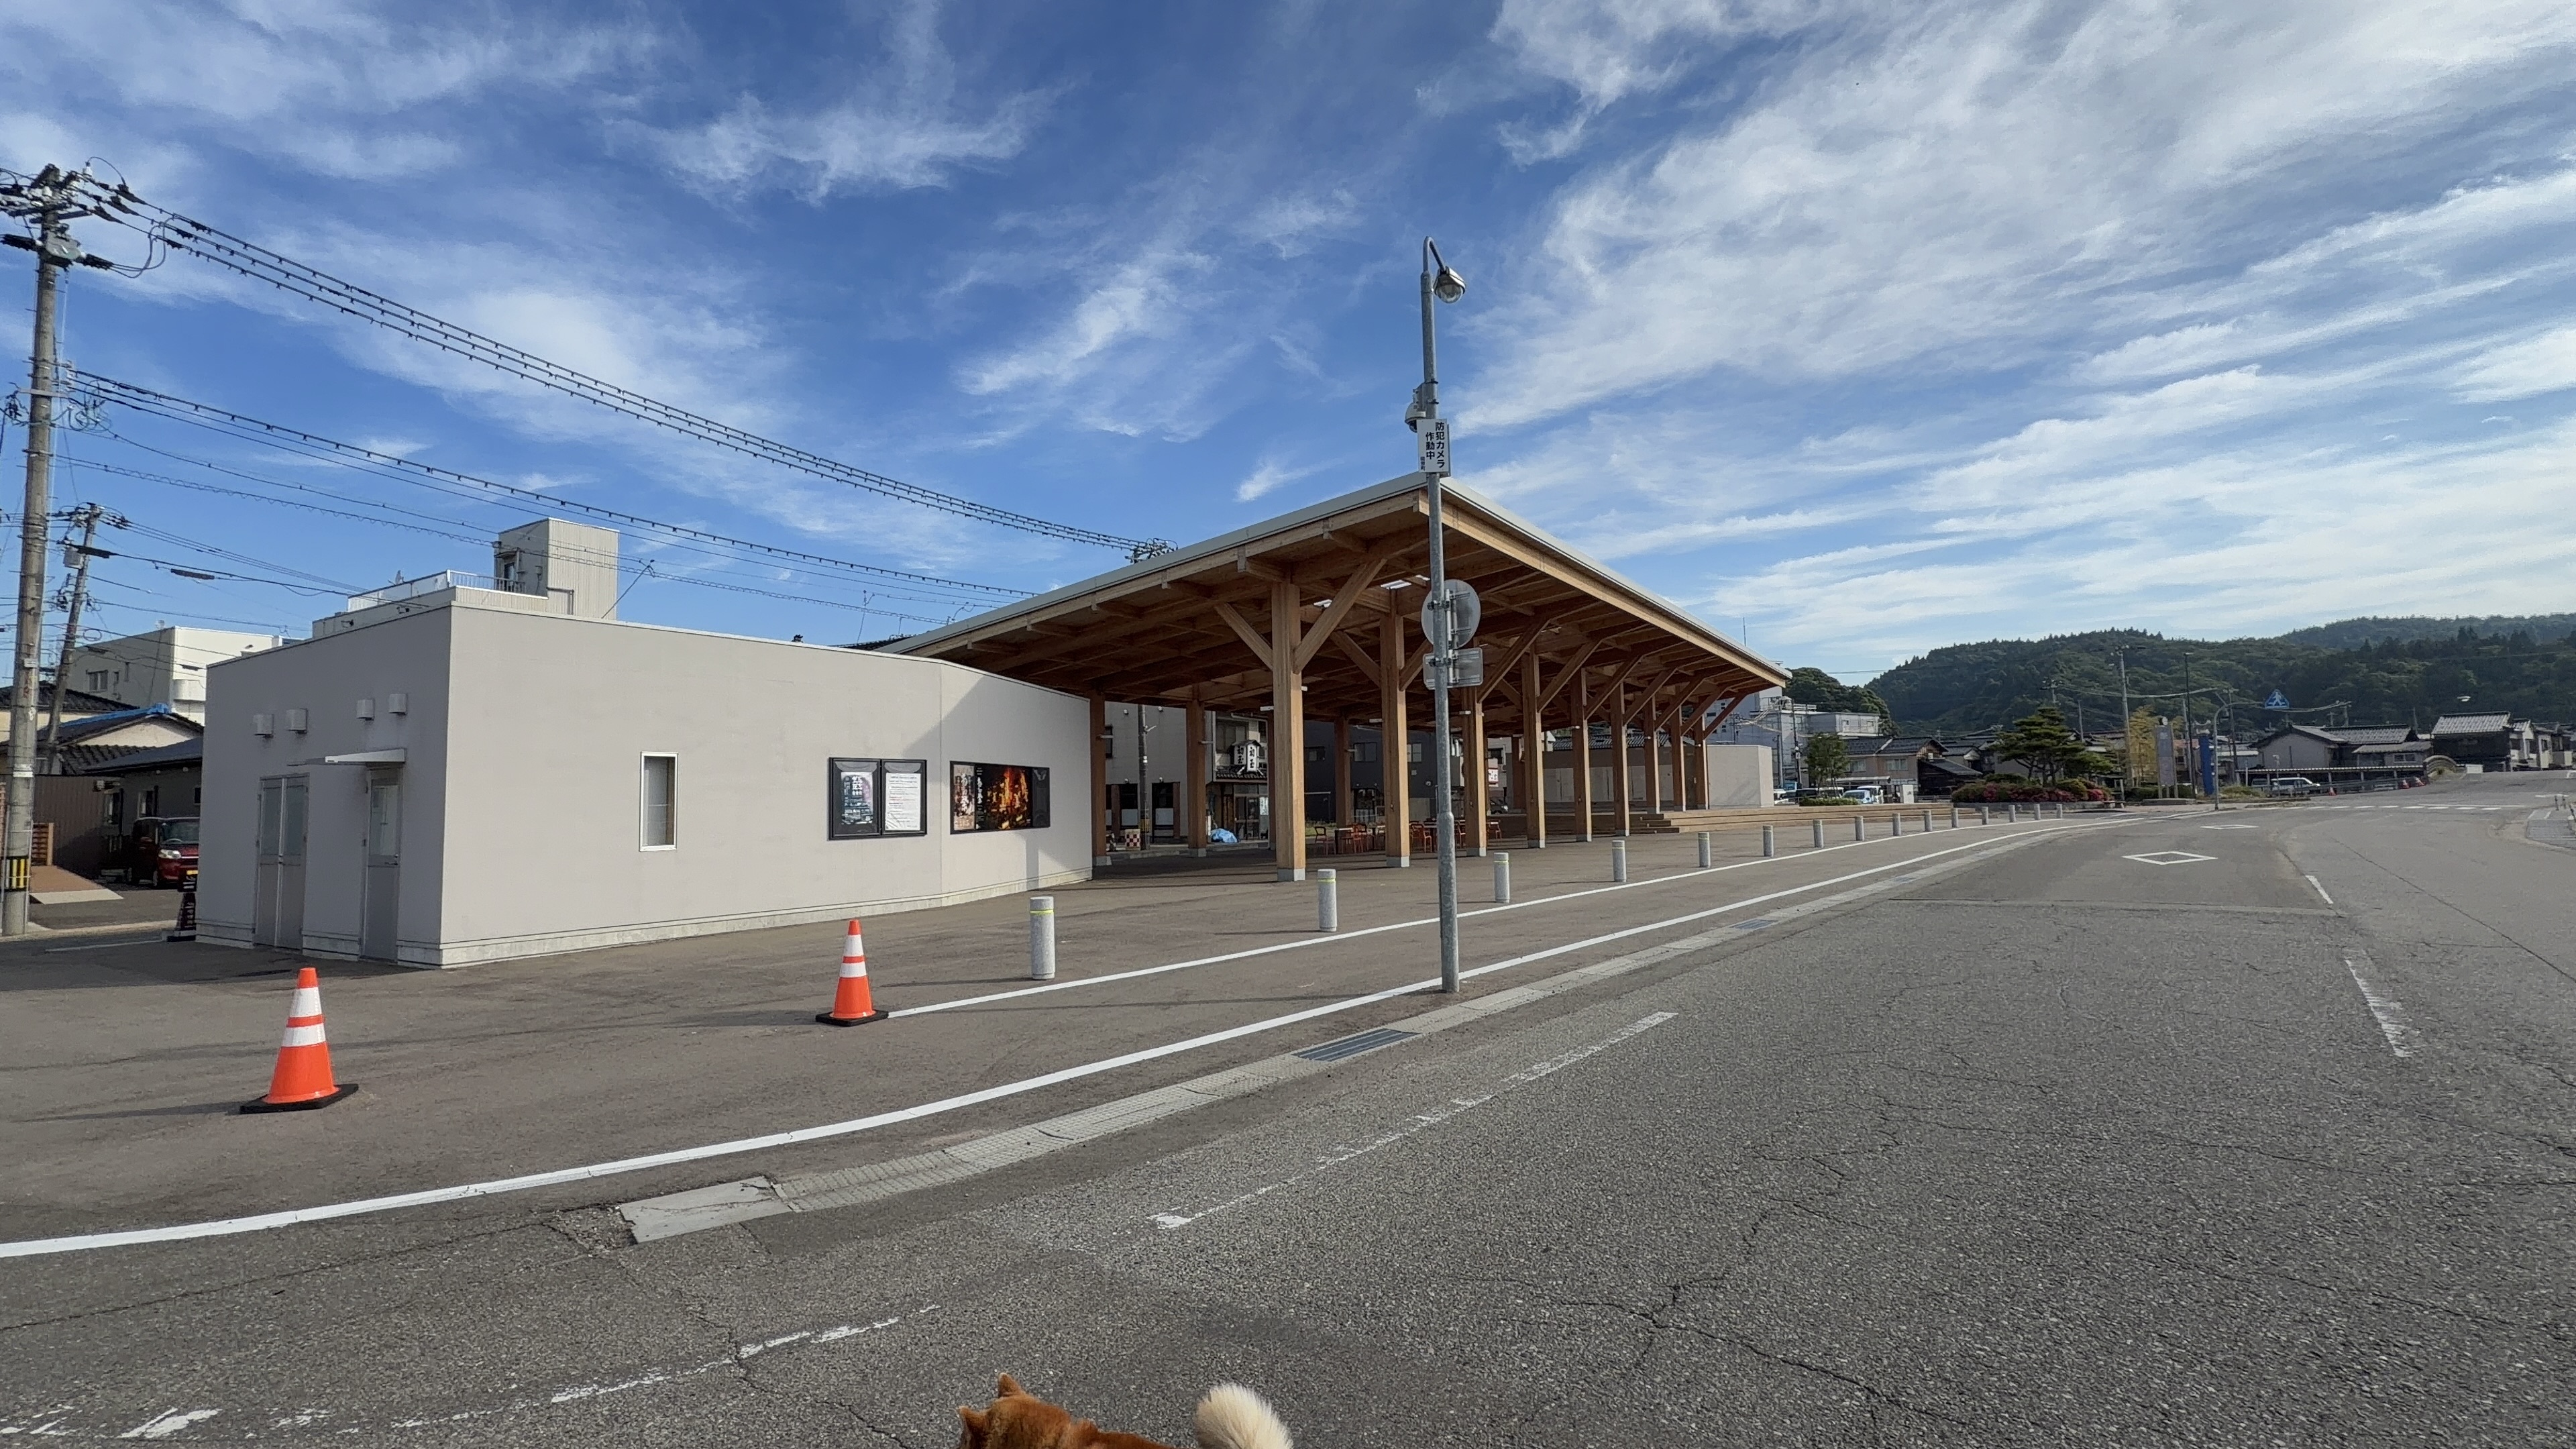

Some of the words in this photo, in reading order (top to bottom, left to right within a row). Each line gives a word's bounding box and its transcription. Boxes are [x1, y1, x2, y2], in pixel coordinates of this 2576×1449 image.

[1426, 431, 1435, 460] 作動中
[1435, 422, 1445, 469] 防犯カメラ
